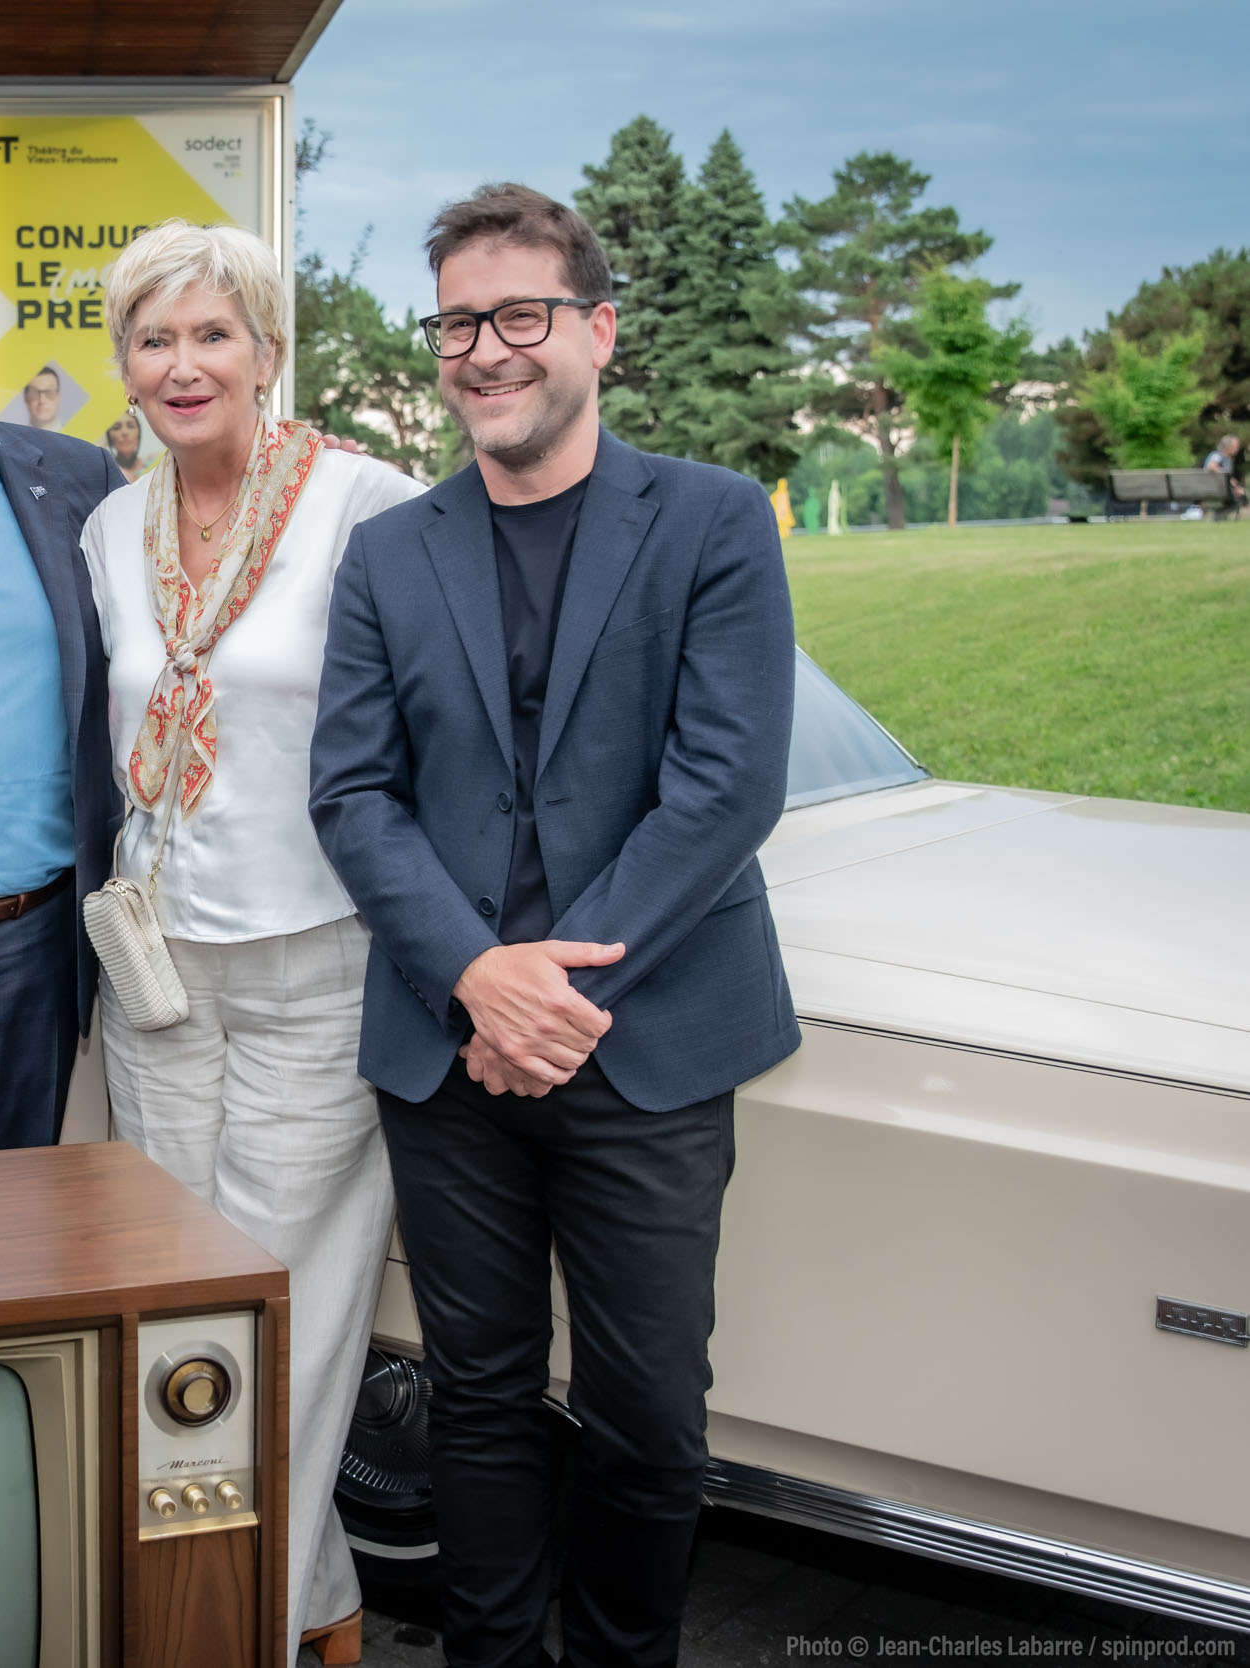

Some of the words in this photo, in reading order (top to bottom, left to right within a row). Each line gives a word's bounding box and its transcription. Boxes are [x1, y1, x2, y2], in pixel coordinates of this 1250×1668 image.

[184, 135, 242, 151] sodect
[17, 290, 103, 329] PRÉ
[156, 1456, 230, 1470] Marconi
